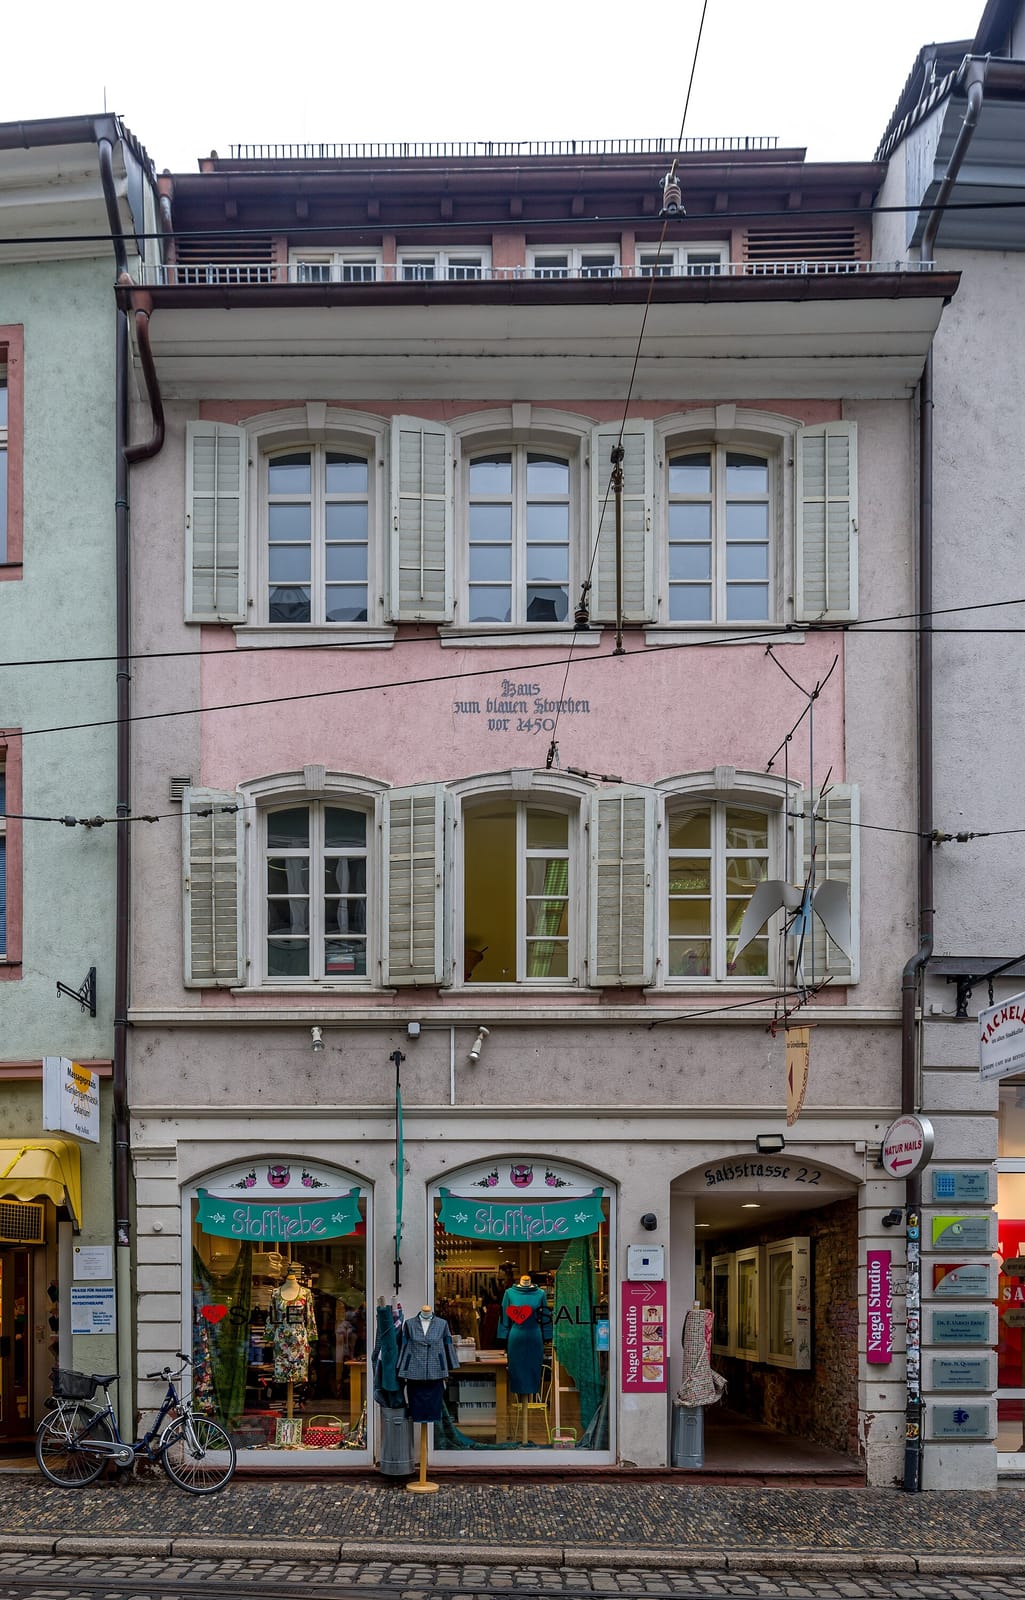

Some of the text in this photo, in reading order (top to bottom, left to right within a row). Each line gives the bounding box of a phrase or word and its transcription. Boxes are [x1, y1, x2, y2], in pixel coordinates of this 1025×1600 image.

[501, 679, 541, 697] Haus
[453, 696, 591, 715] zum blauen Storchen
[488, 718, 555, 735] vor 1450
[884, 1139, 922, 1156] NATUR NAILS
[704, 1162, 822, 1187] Salzstrasse 22
[1002, 1286, 1025, 1301] SA
[229, 1305, 304, 1325] SALE
[868, 1260, 885, 1352] Nagel Studio
[626, 1305, 640, 1383] Nagel Studio
